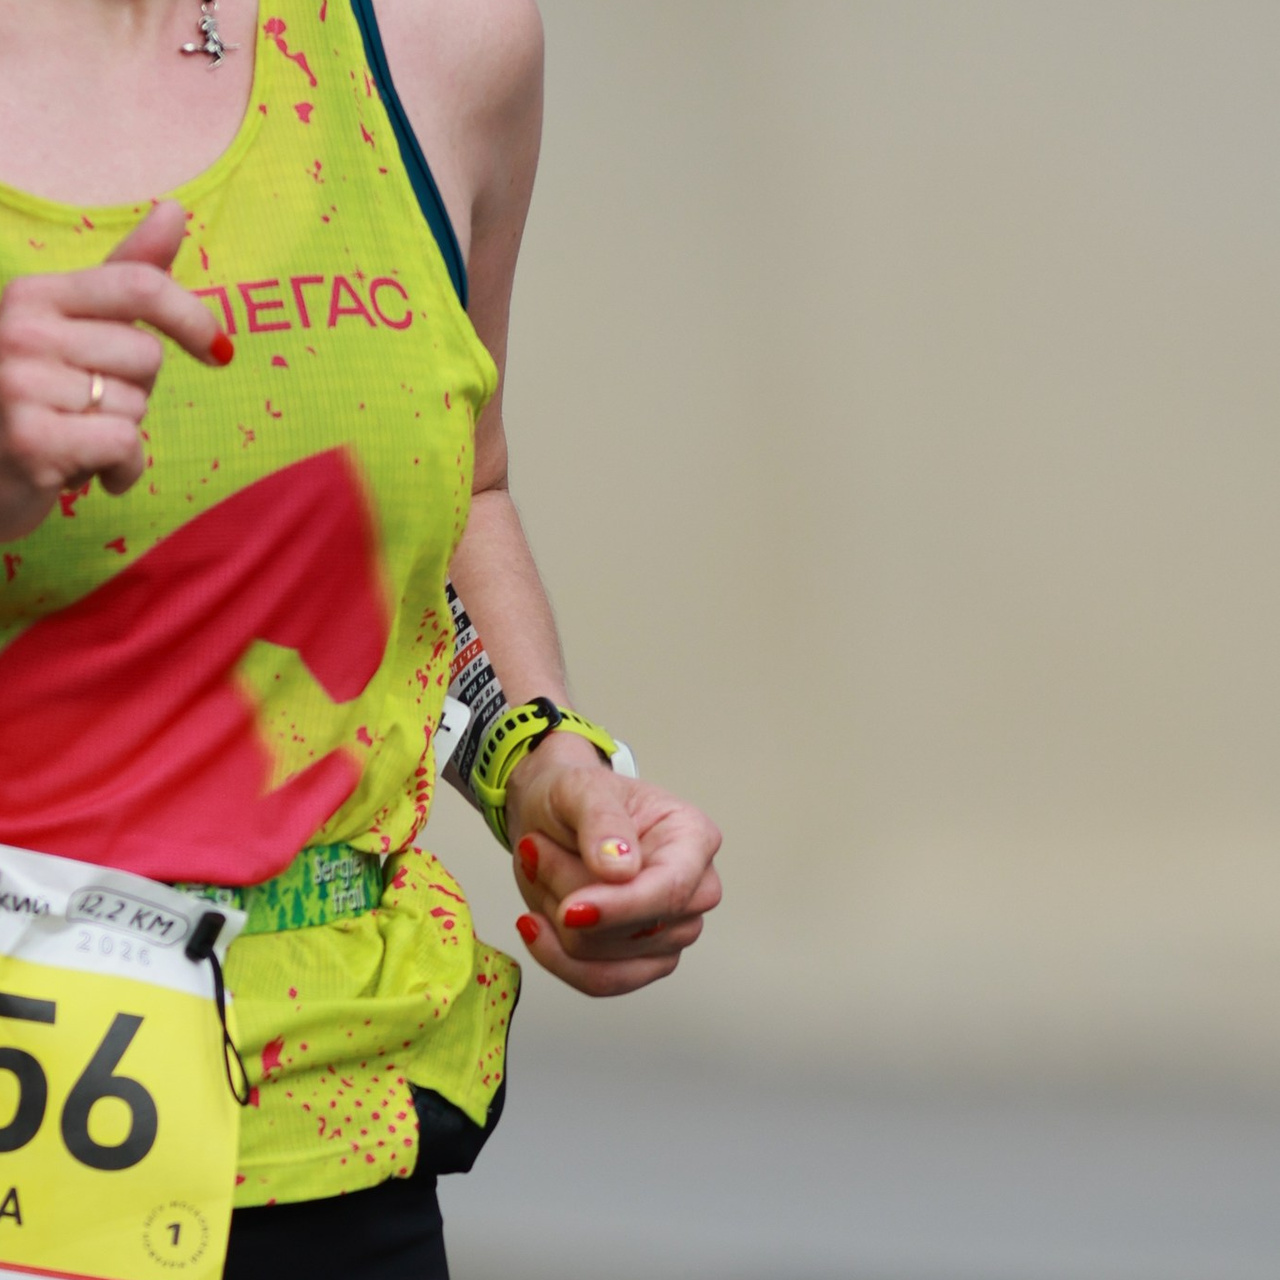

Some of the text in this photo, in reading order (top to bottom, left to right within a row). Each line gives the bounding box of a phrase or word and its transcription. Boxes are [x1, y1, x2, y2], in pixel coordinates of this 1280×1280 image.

[190, 275, 413, 335] ПЕГАС
[459, 643, 478, 667] 21.1
[465, 671, 489, 700] 15 KM
[333, 880, 367, 913] trail
[166, 1222, 181, 1246] 1
